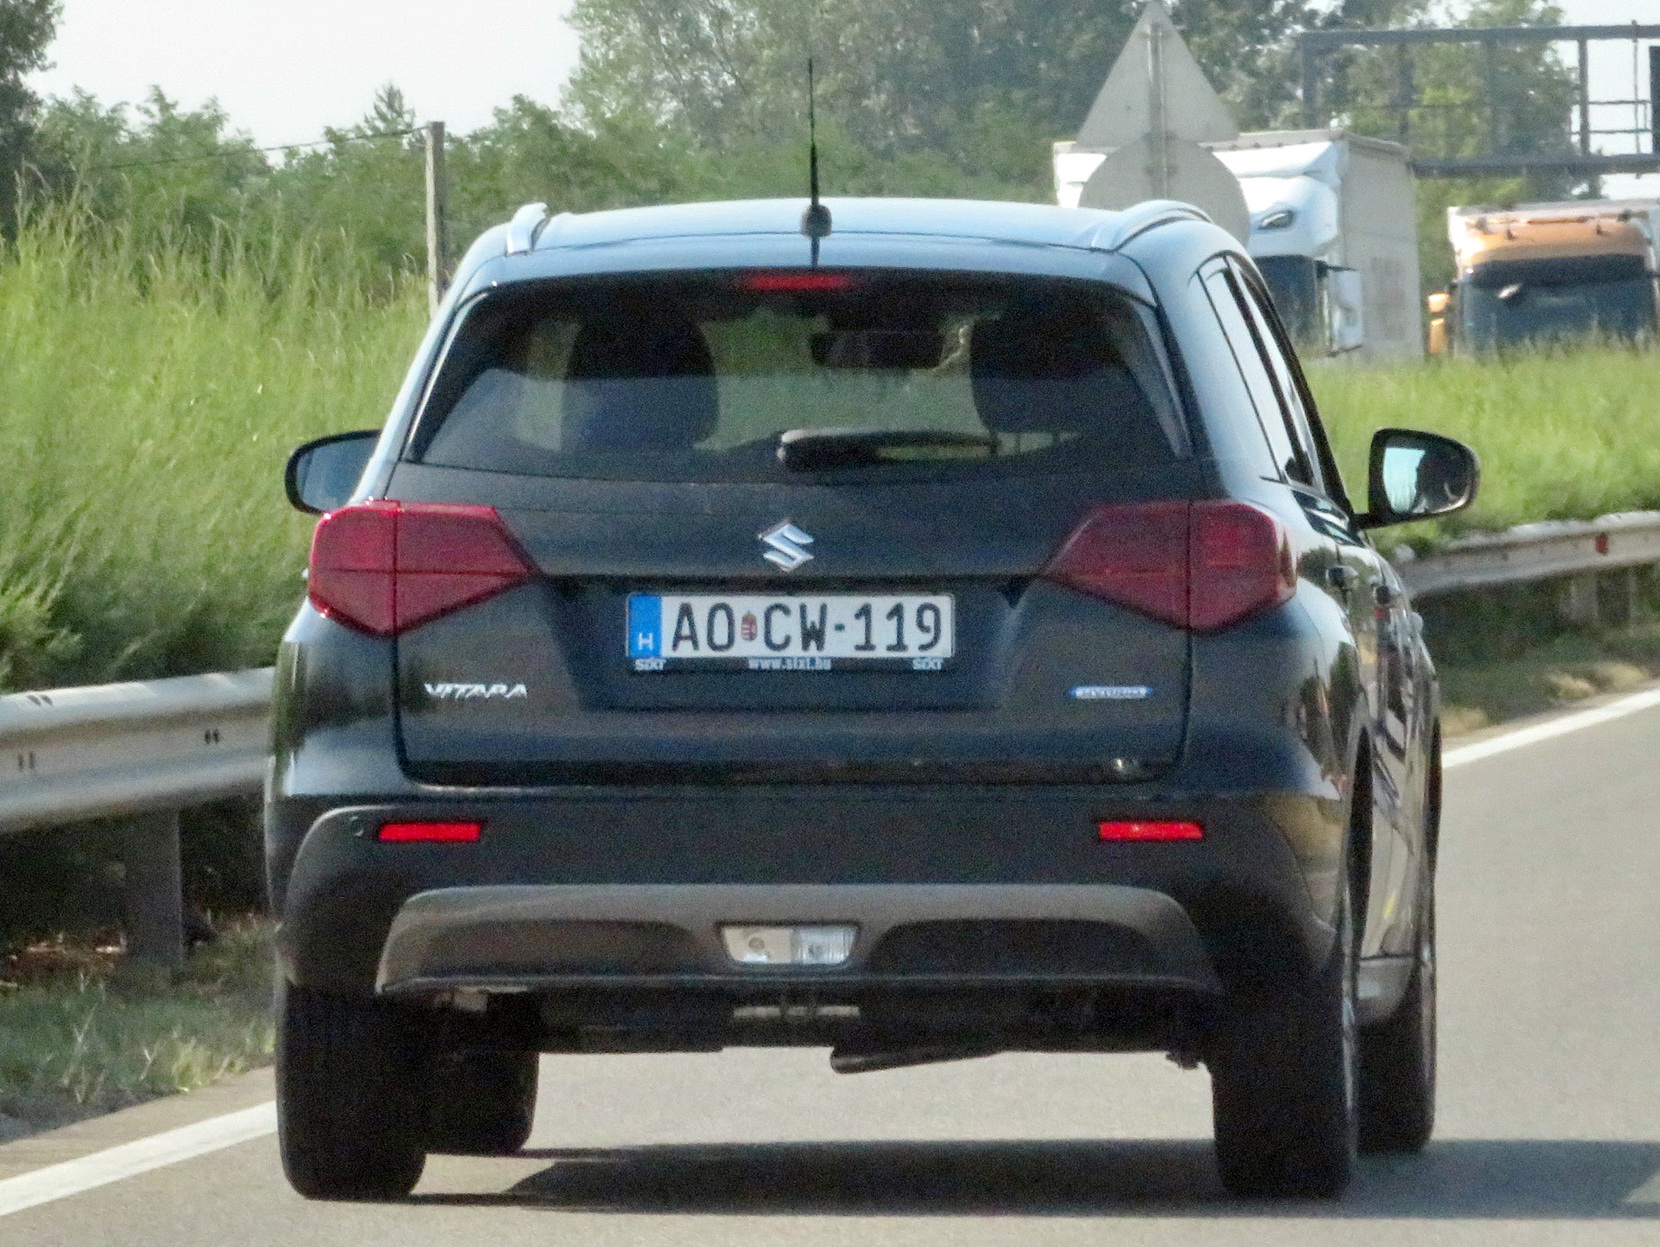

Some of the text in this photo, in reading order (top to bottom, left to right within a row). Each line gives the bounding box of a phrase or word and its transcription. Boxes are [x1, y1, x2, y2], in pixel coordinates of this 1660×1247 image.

[671, 602, 942, 652] AO CW-119
[637, 632, 654, 650] H
[423, 683, 528, 699] VITARA
